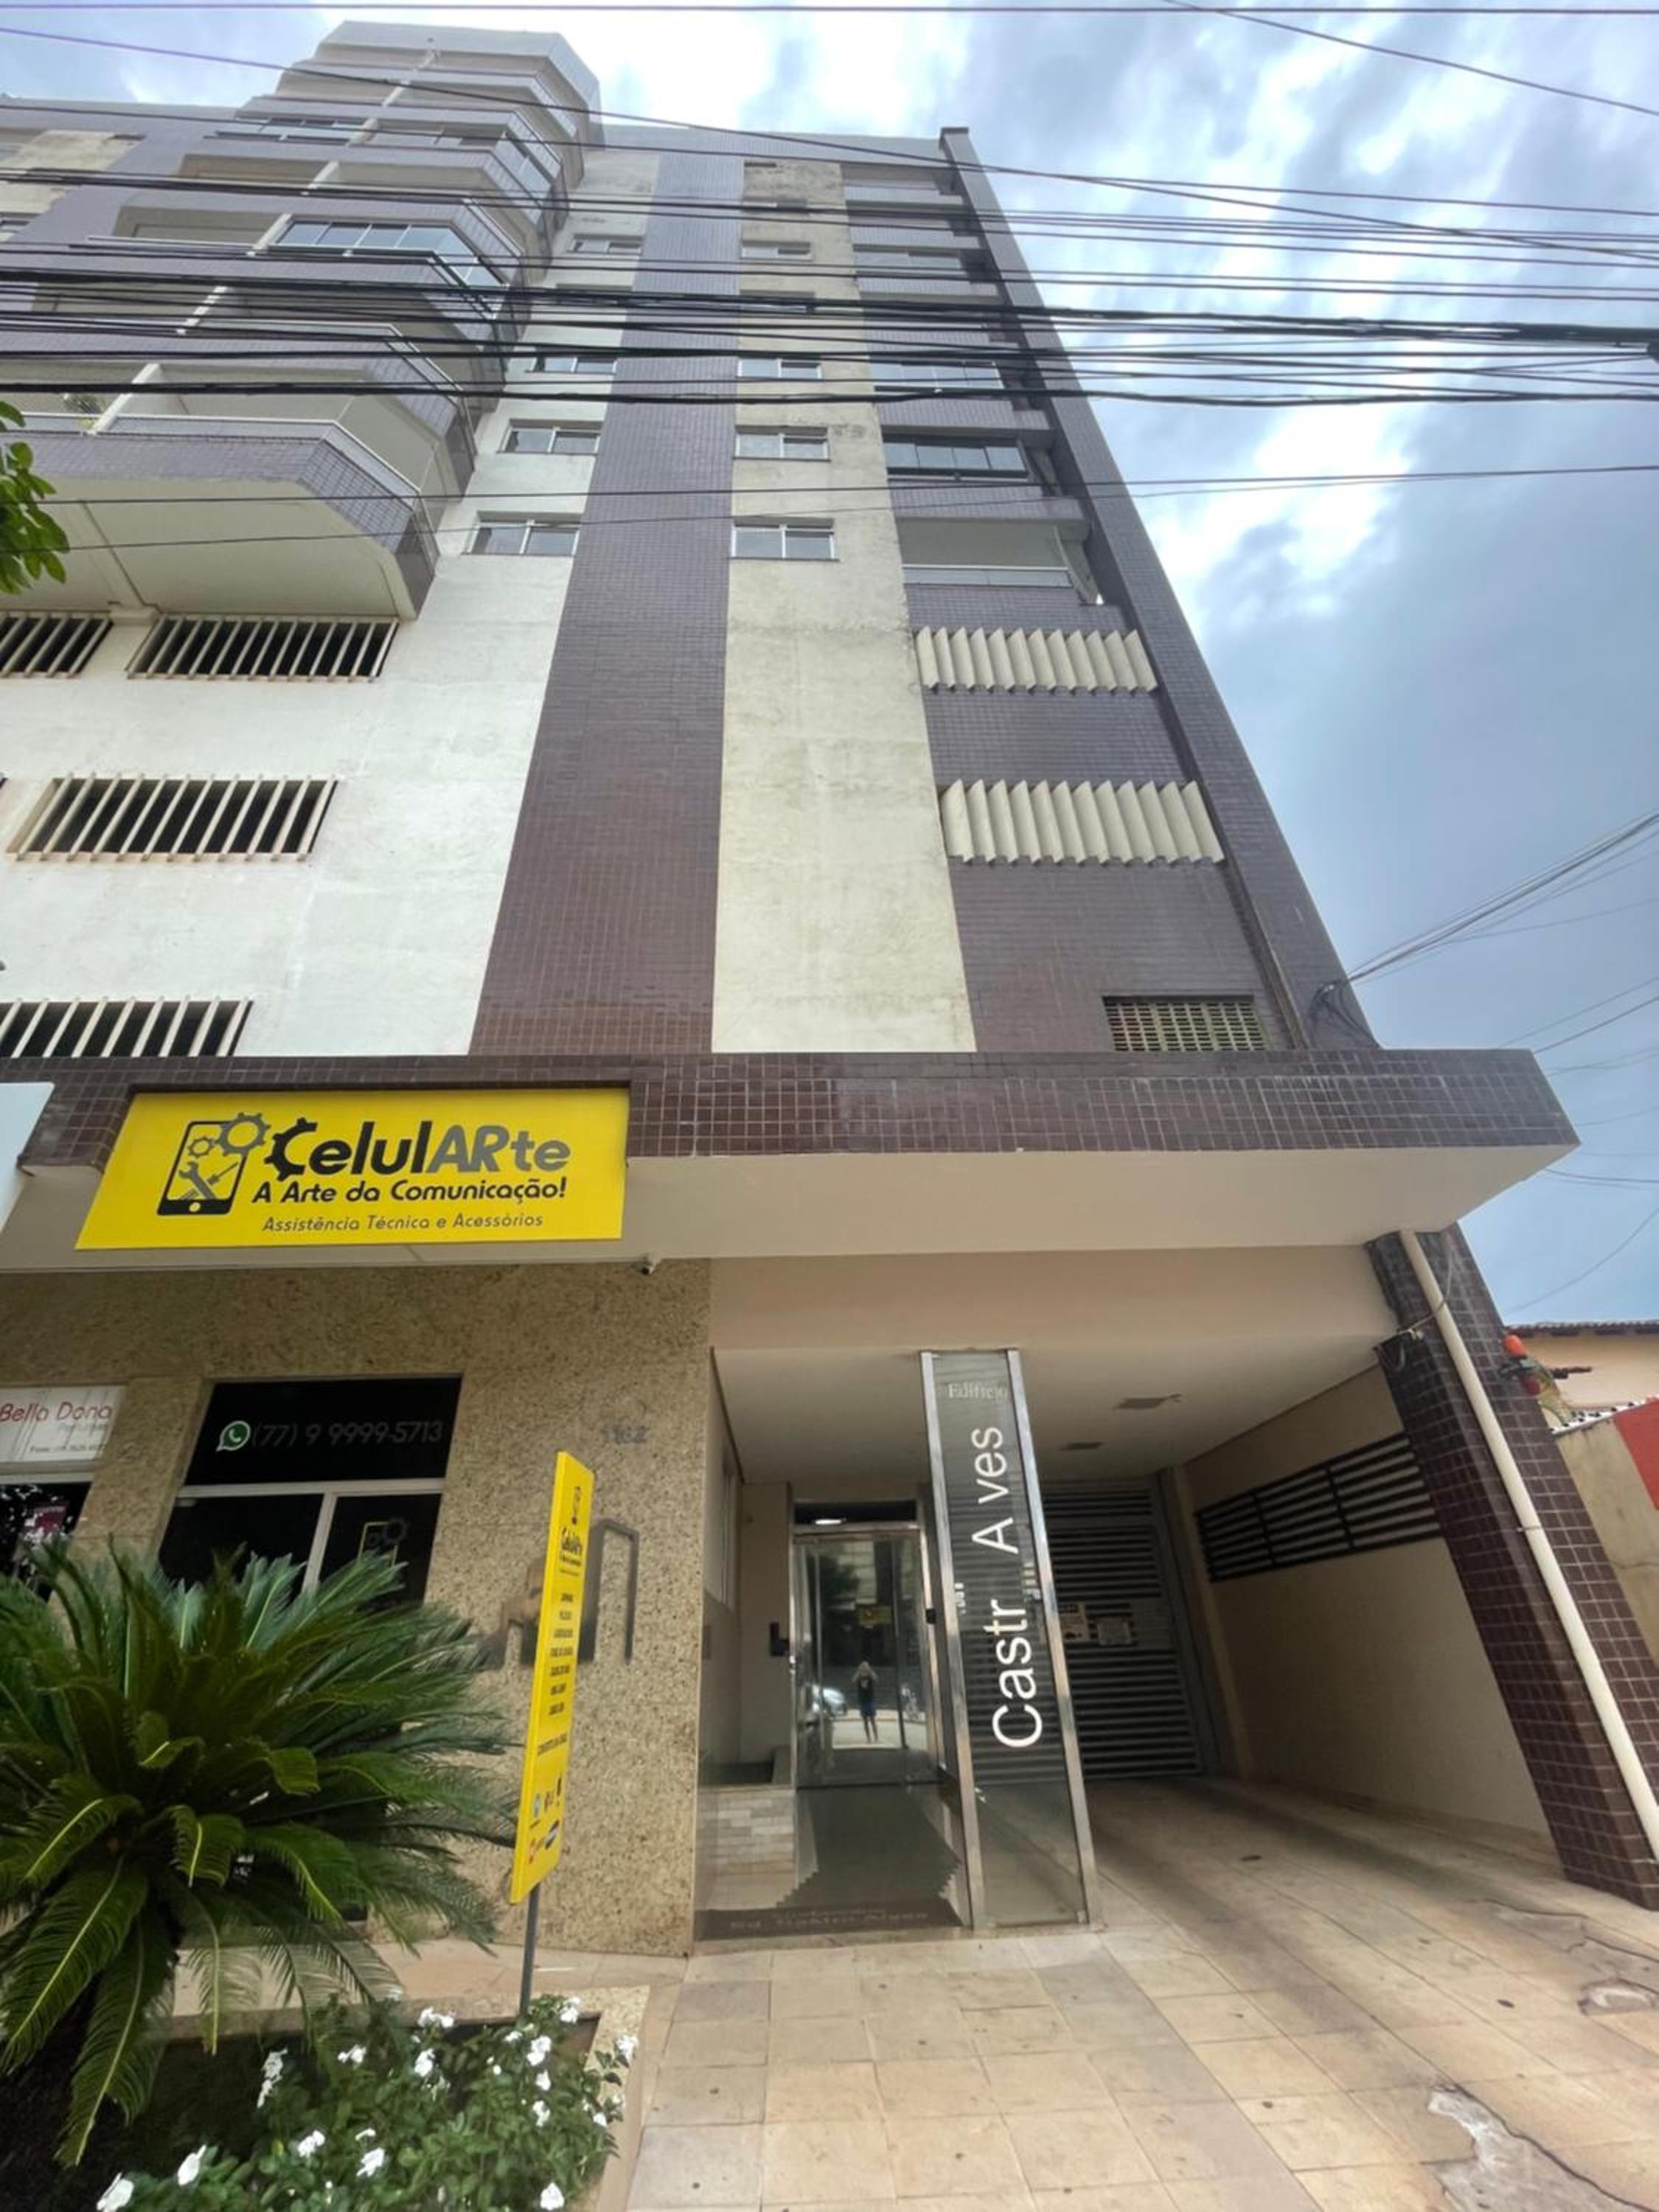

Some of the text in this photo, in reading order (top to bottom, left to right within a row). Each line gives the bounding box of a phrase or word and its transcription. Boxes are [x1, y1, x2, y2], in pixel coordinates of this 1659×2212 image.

[264, 1117, 571, 1181] CelulARte
[251, 1176, 567, 1204] A Arte da Comunicação!
[262, 1211, 543, 1231] Assistência Técnica e Acessórios
[0, 1402, 112, 1422] Bella Dona
[252, 1420, 442, 1447] (77) 9 9999-5713
